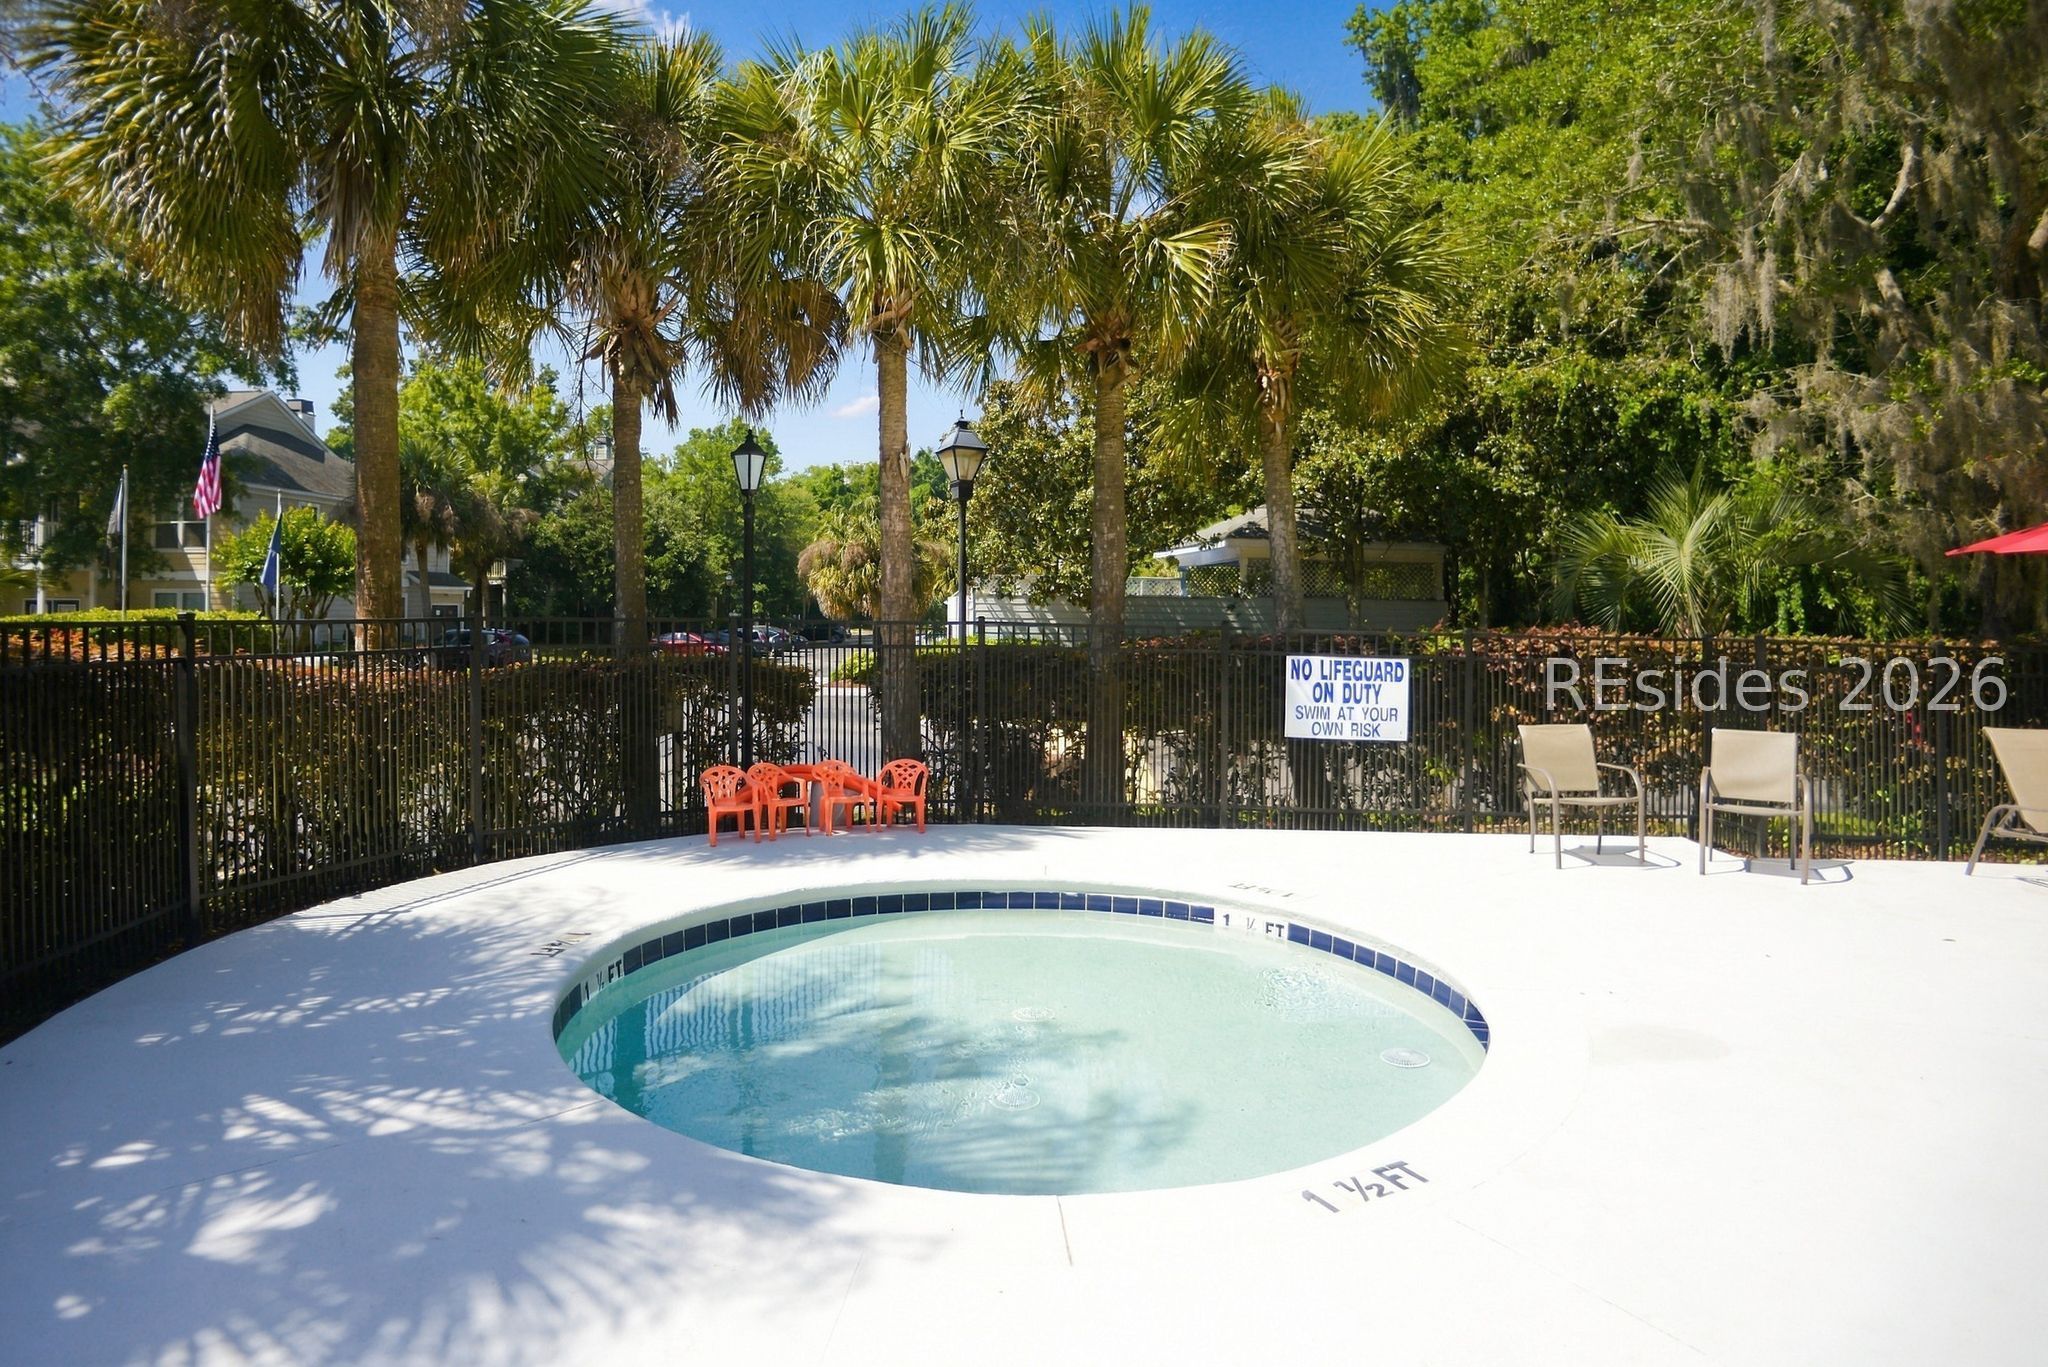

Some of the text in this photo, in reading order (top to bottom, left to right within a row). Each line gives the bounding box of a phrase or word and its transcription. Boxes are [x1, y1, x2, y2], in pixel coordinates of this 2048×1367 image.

[1291, 658, 1404, 682] NO LIFEGUARD
[1312, 682, 1382, 704] ON DUTY
[1295, 705, 1398, 722] SWIM AT YOUR
[1311, 721, 1381, 737] OWN RISK
[1265, 921, 1285, 937] FT
[607, 959, 622, 984] FT
[1302, 1190, 1340, 1213] 1
